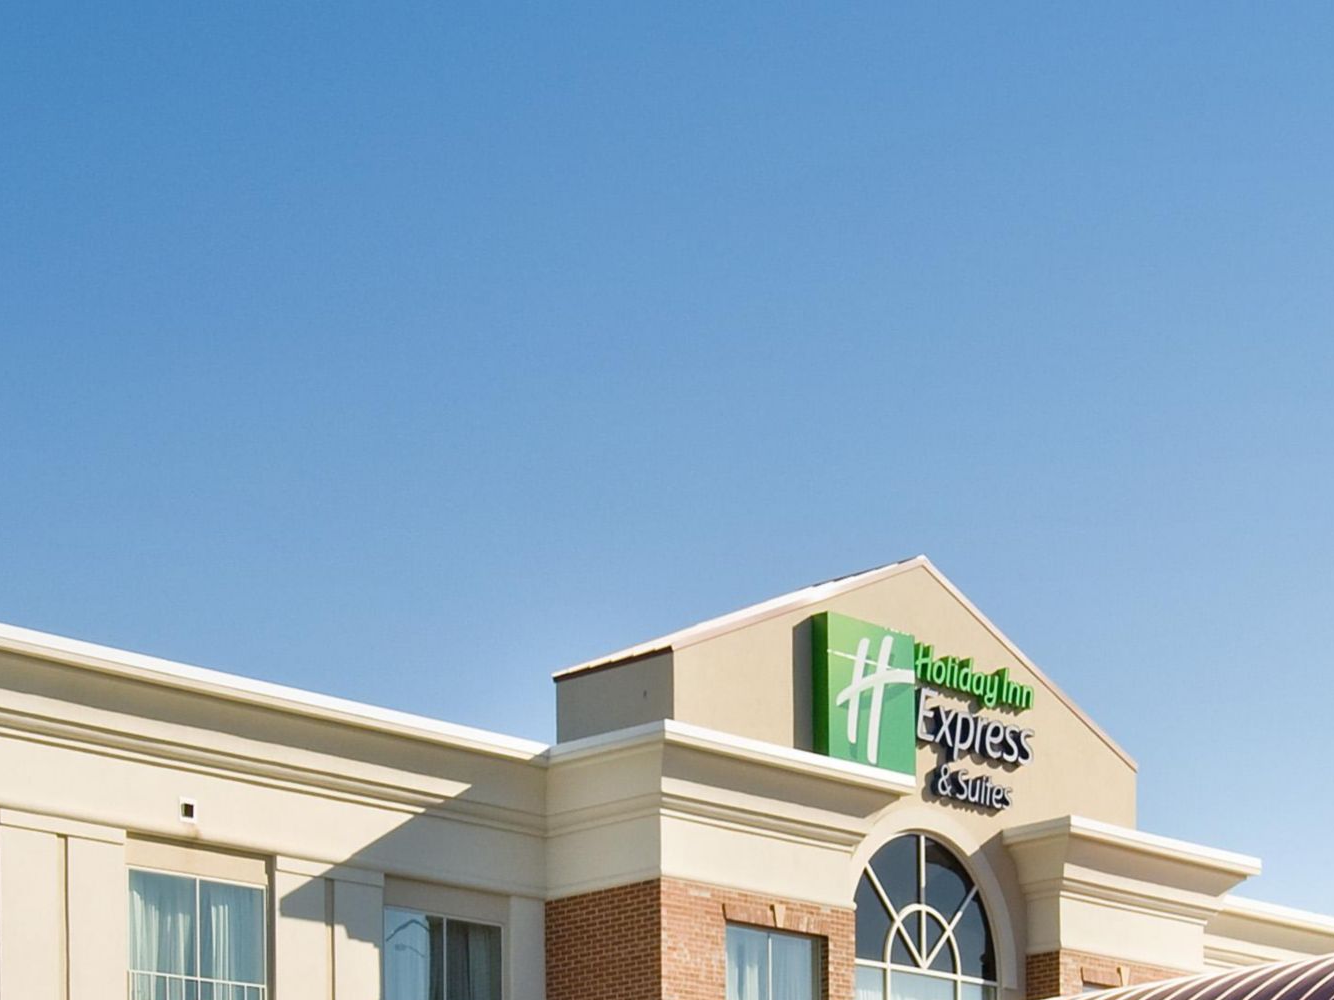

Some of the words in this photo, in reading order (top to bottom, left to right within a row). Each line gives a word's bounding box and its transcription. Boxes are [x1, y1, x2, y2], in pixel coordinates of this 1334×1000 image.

[915, 643, 999, 708] Holiday
[1002, 667, 1035, 710] Inn
[916, 686, 1035, 767] Express
[937, 763, 953, 797] &
[955, 769, 1014, 811] Suites
